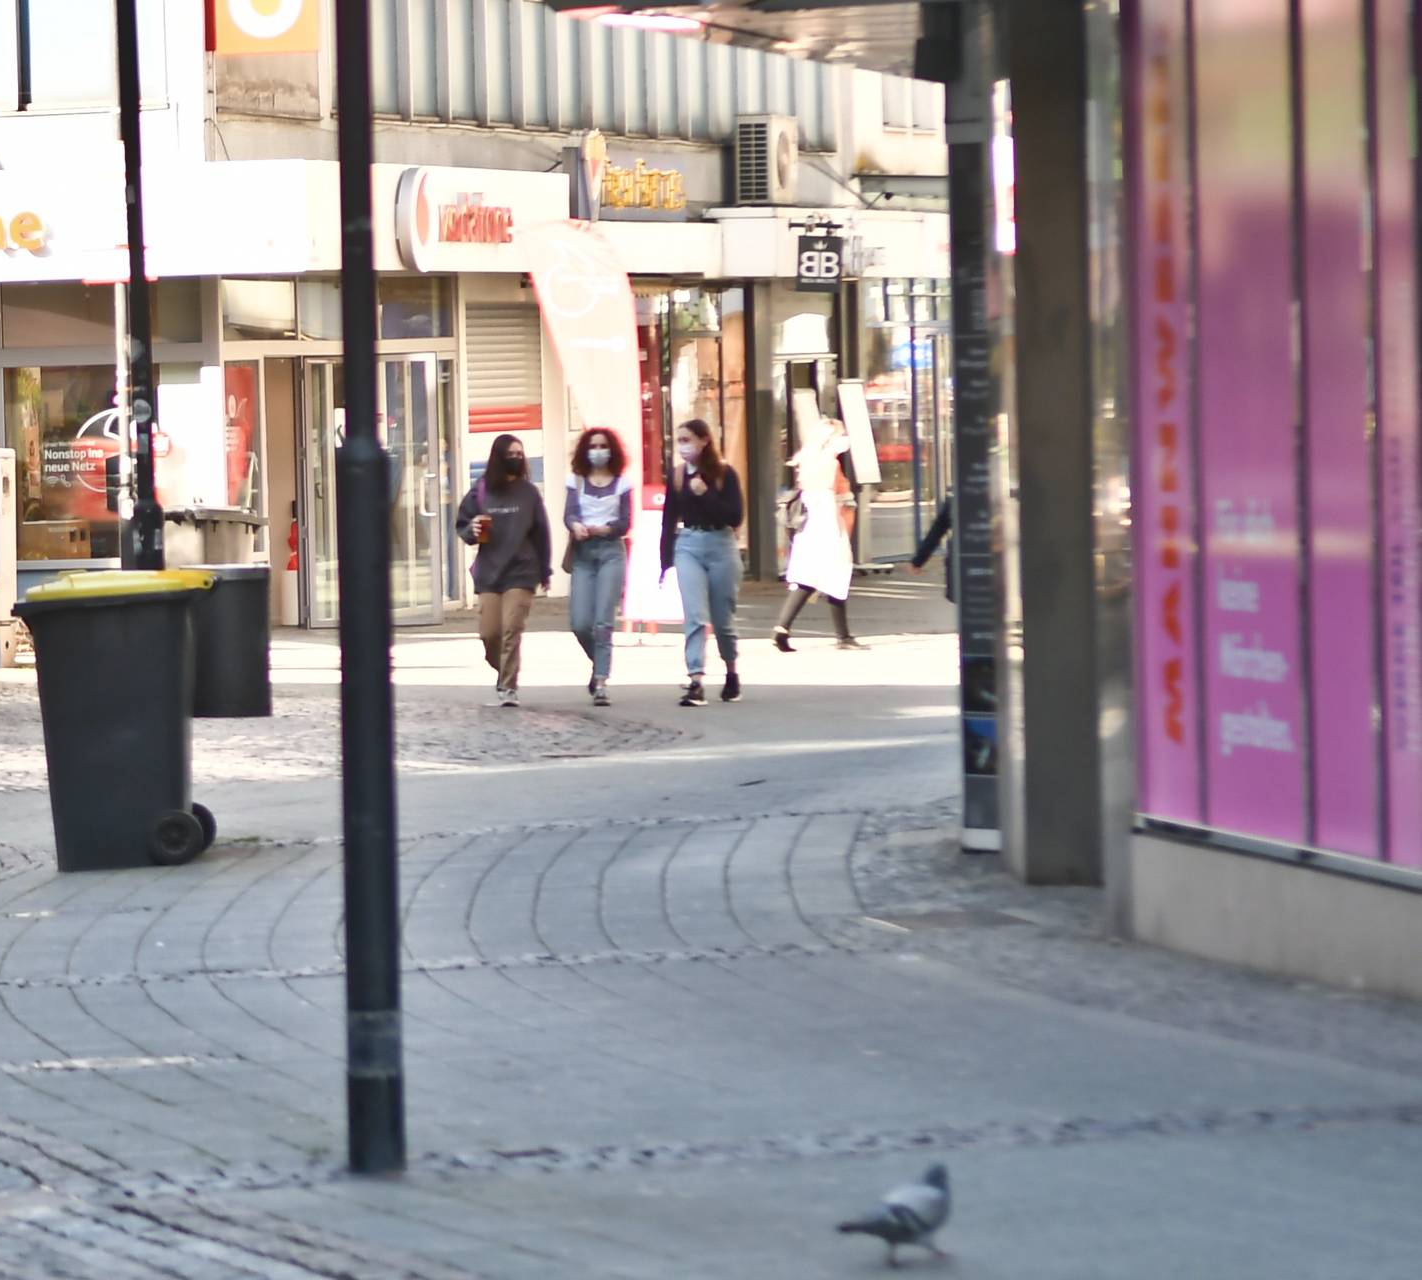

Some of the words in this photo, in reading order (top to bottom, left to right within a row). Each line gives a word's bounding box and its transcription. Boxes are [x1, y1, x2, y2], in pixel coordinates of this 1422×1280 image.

[44, 449, 87, 461] Nonstop
[88, 448, 104, 458] ins
[44, 463, 70, 473] neue
[72, 461, 96, 472] Netz
